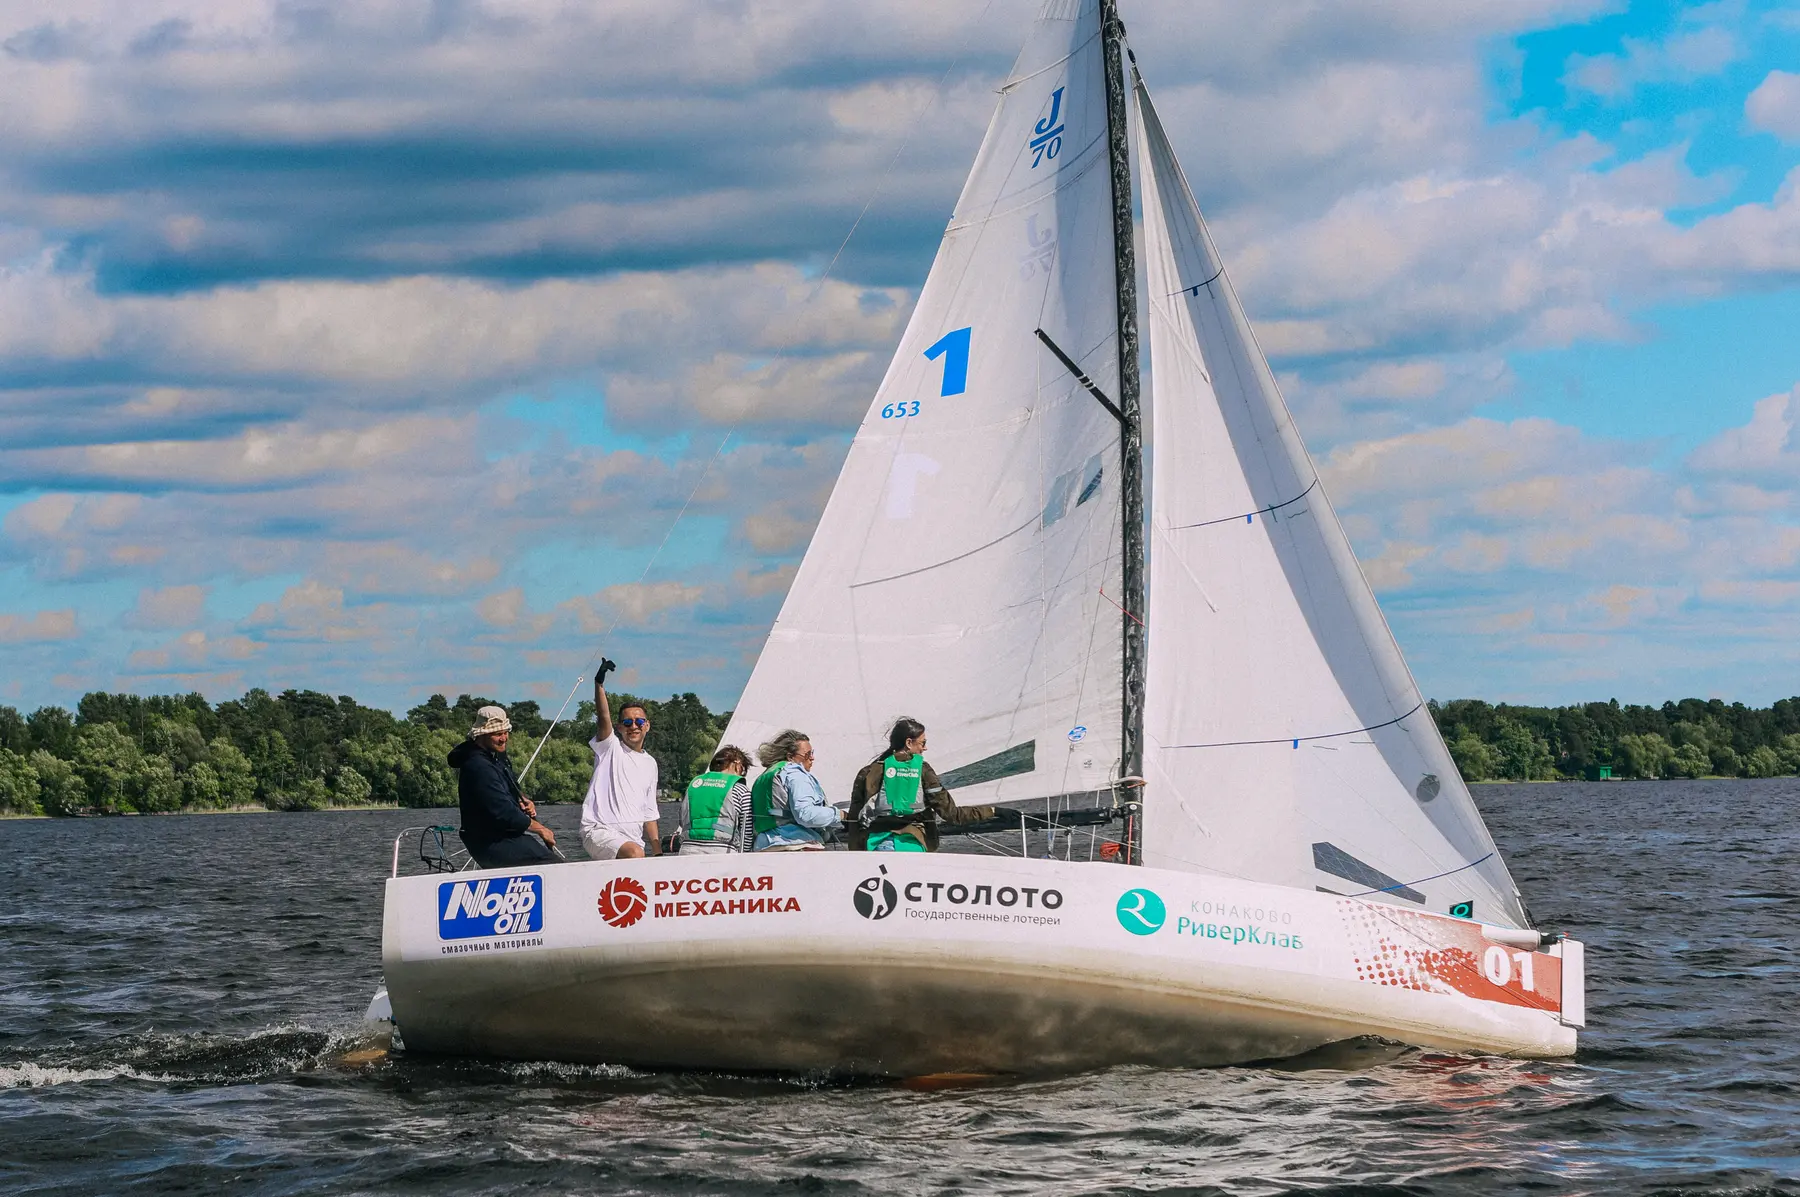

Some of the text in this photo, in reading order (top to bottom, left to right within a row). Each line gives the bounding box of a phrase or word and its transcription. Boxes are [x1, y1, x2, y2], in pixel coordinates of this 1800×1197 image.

[1035, 86, 1065, 134] J
[1032, 136, 1062, 169] 70
[923, 326, 972, 397] 1
[881, 400, 921, 419] 653
[654, 876, 774, 896] РУССКАЯ
[904, 881, 1063, 910] СТОЛОТО
[654, 897, 801, 918] МЕХАНИКА
[905, 908, 1061, 926] Государственные лотереи
[1191, 900, 1292, 925] КОНАКОВО
[494, 913, 531, 934] OIL
[1177, 916, 1304, 950] РиверКлаб
[441, 938, 543, 954] смазочные материалы
[1484, 946, 1534, 991] 01
